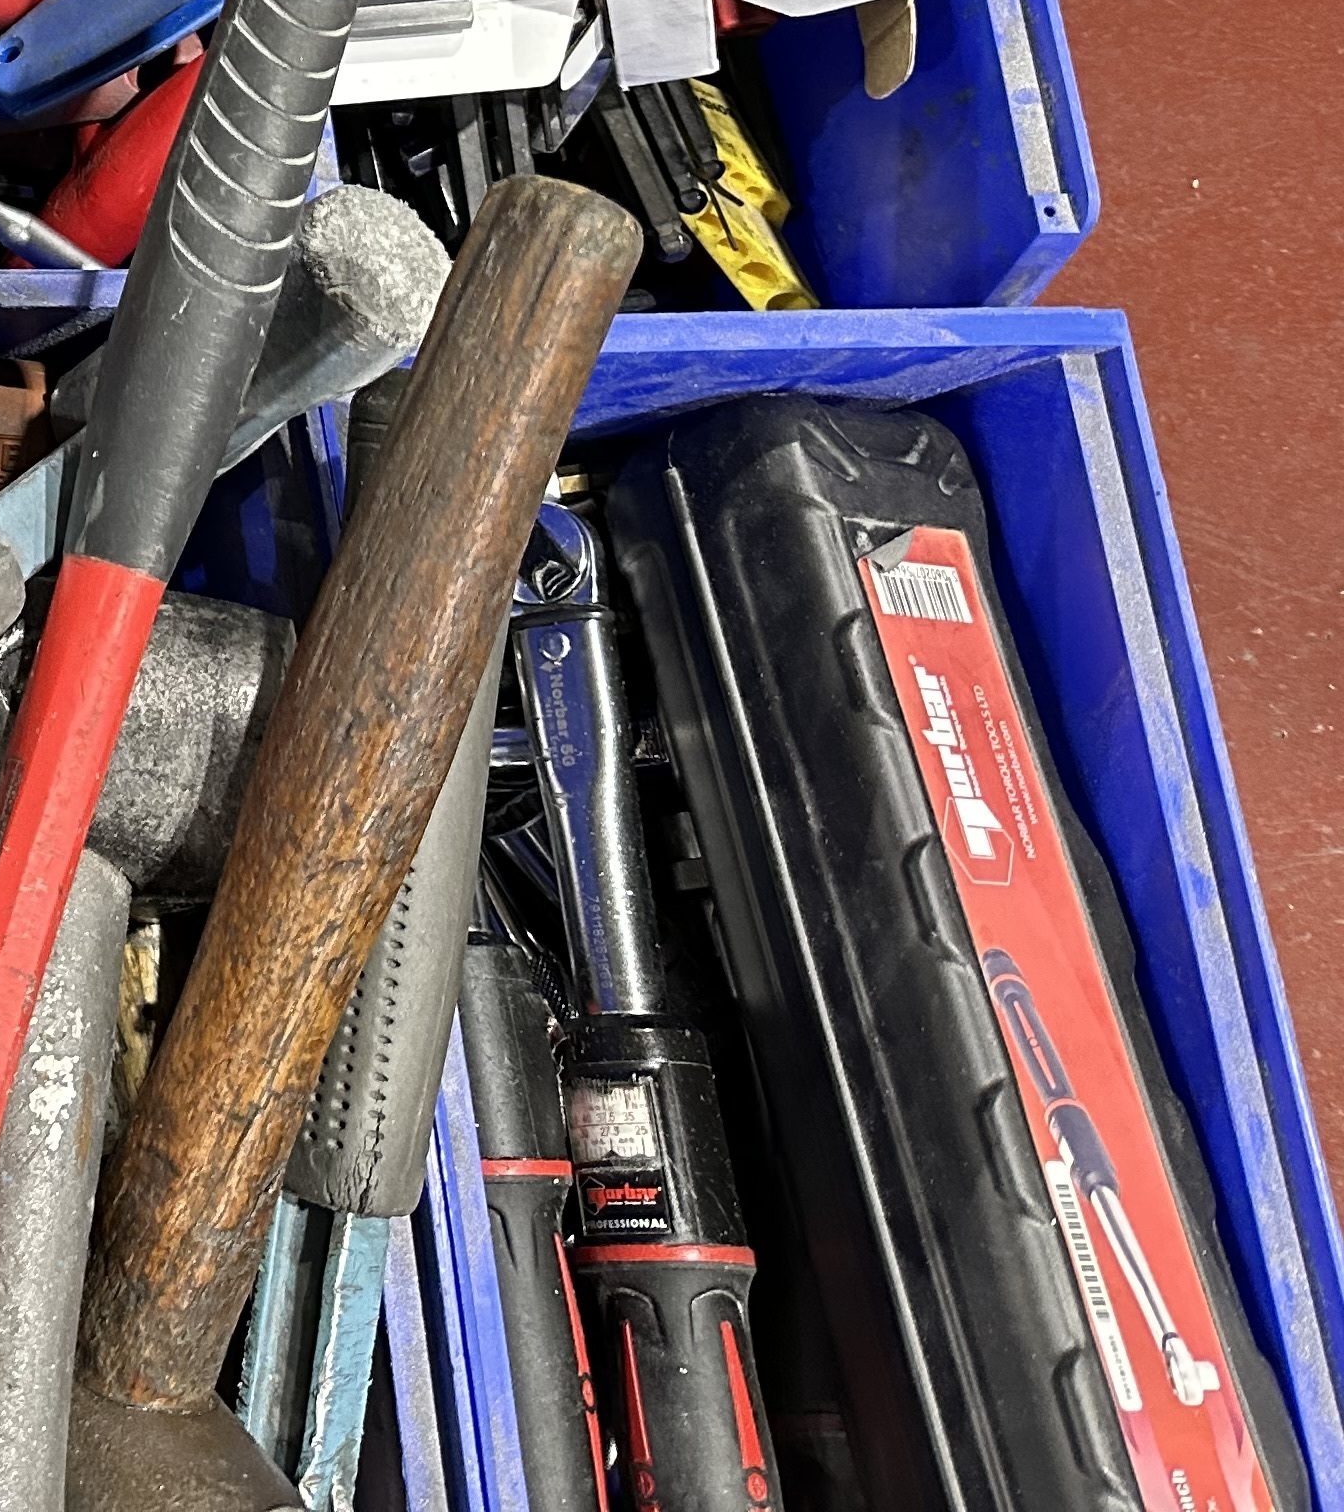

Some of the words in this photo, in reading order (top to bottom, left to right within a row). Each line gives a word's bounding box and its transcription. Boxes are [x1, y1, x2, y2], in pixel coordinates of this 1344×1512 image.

[549, 673, 570, 739] Norbar
[972, 684, 987, 709] LTD
[981, 710, 1000, 750] TOOLS
[994, 751, 1019, 804] TORQUE
[1011, 805, 1037, 859] NORBAR
[623, 1111, 635, 1122] 35
[585, 1217, 668, 1230] PROFESSIONAL
